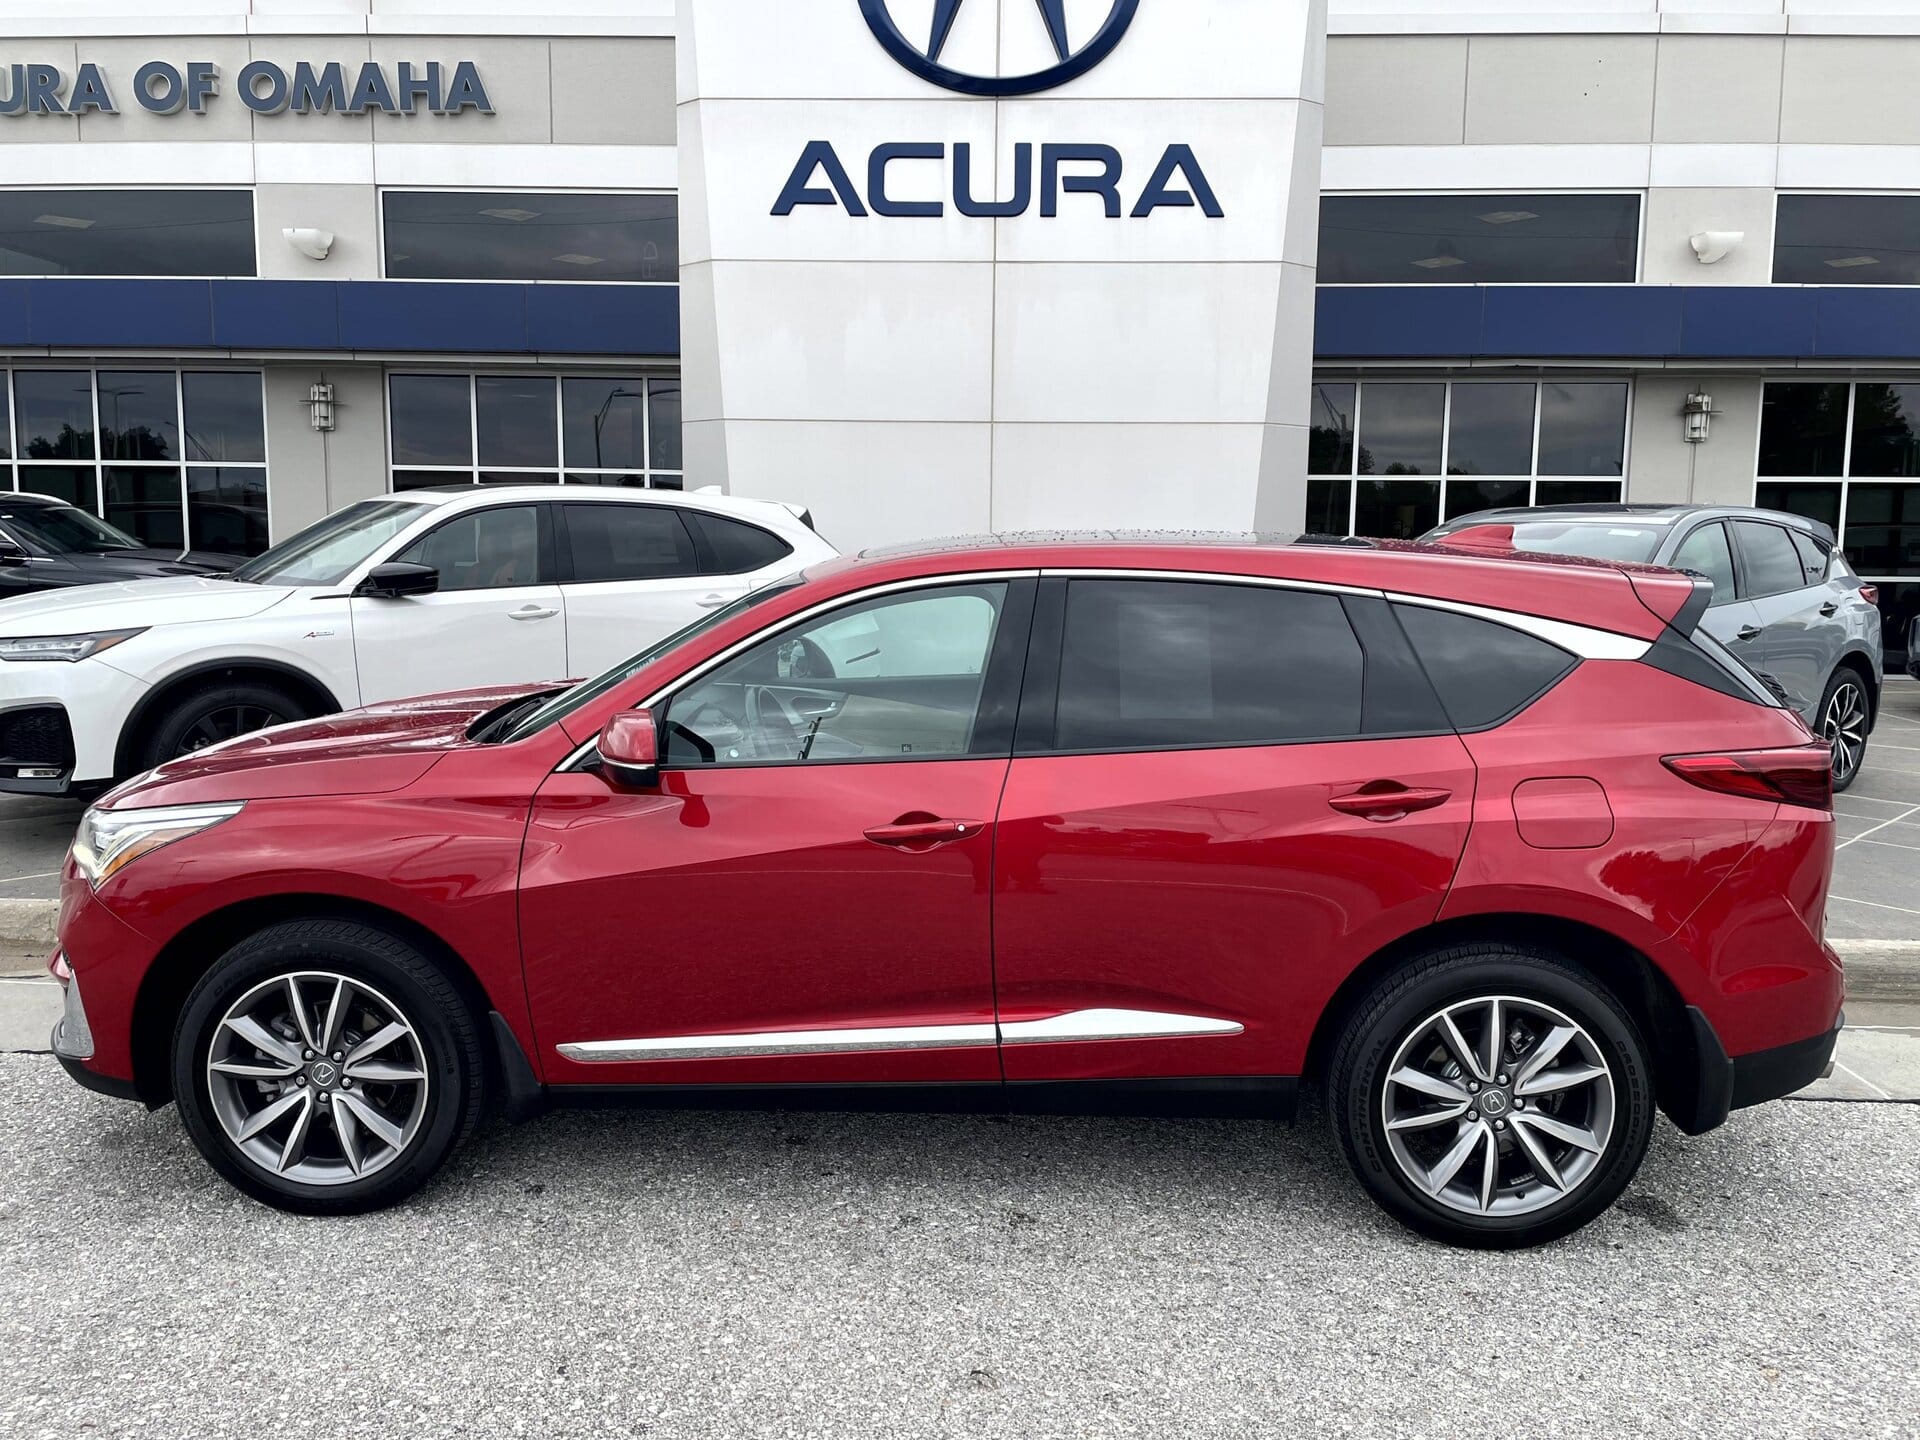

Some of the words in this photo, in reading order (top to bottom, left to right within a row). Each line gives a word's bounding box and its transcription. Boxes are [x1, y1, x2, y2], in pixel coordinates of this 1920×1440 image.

[133, 60, 216, 114] OF
[237, 60, 494, 114] OMAHA
[770, 141, 1224, 218] ACURA
